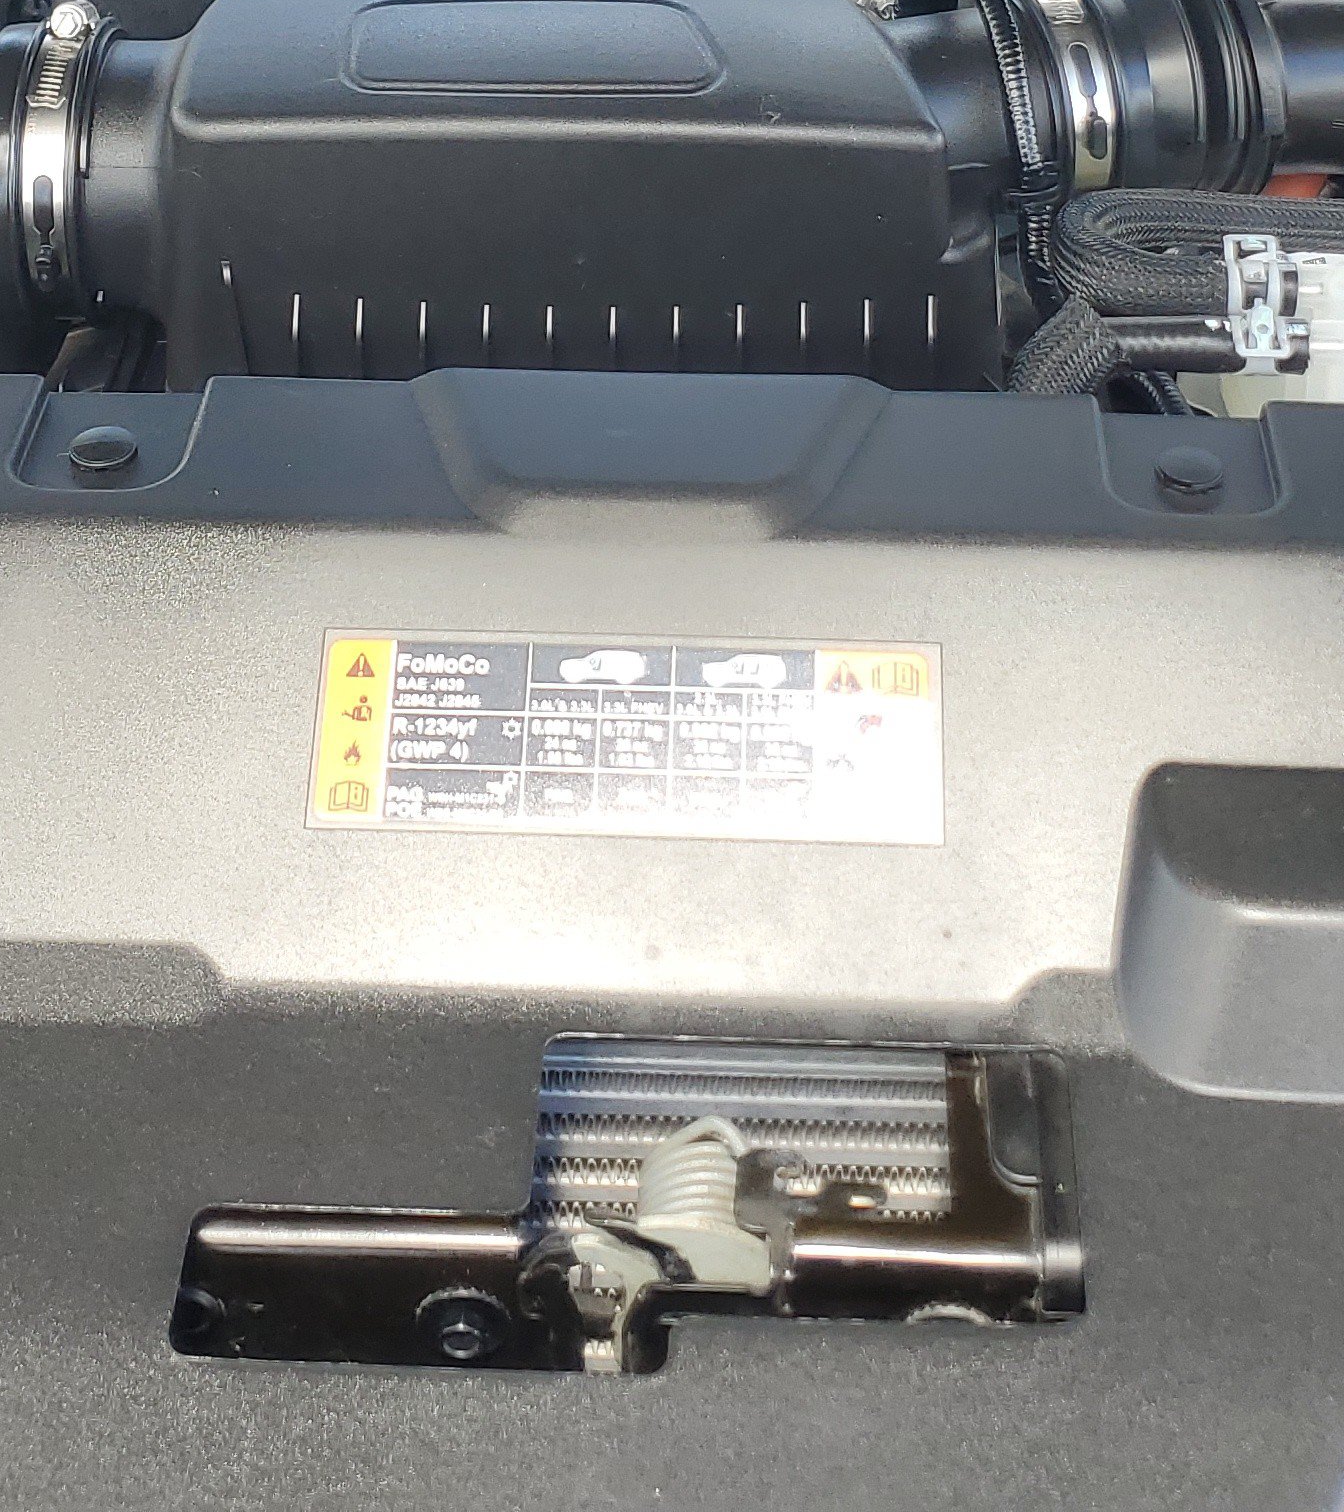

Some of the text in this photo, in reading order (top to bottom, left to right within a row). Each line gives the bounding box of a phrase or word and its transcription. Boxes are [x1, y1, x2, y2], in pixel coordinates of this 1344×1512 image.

[396, 653, 491, 675] FoMoCo
[396, 676, 465, 691] SAE J639
[391, 716, 478, 740] R-1234yf
[389, 740, 470, 763] (GWP 4)
